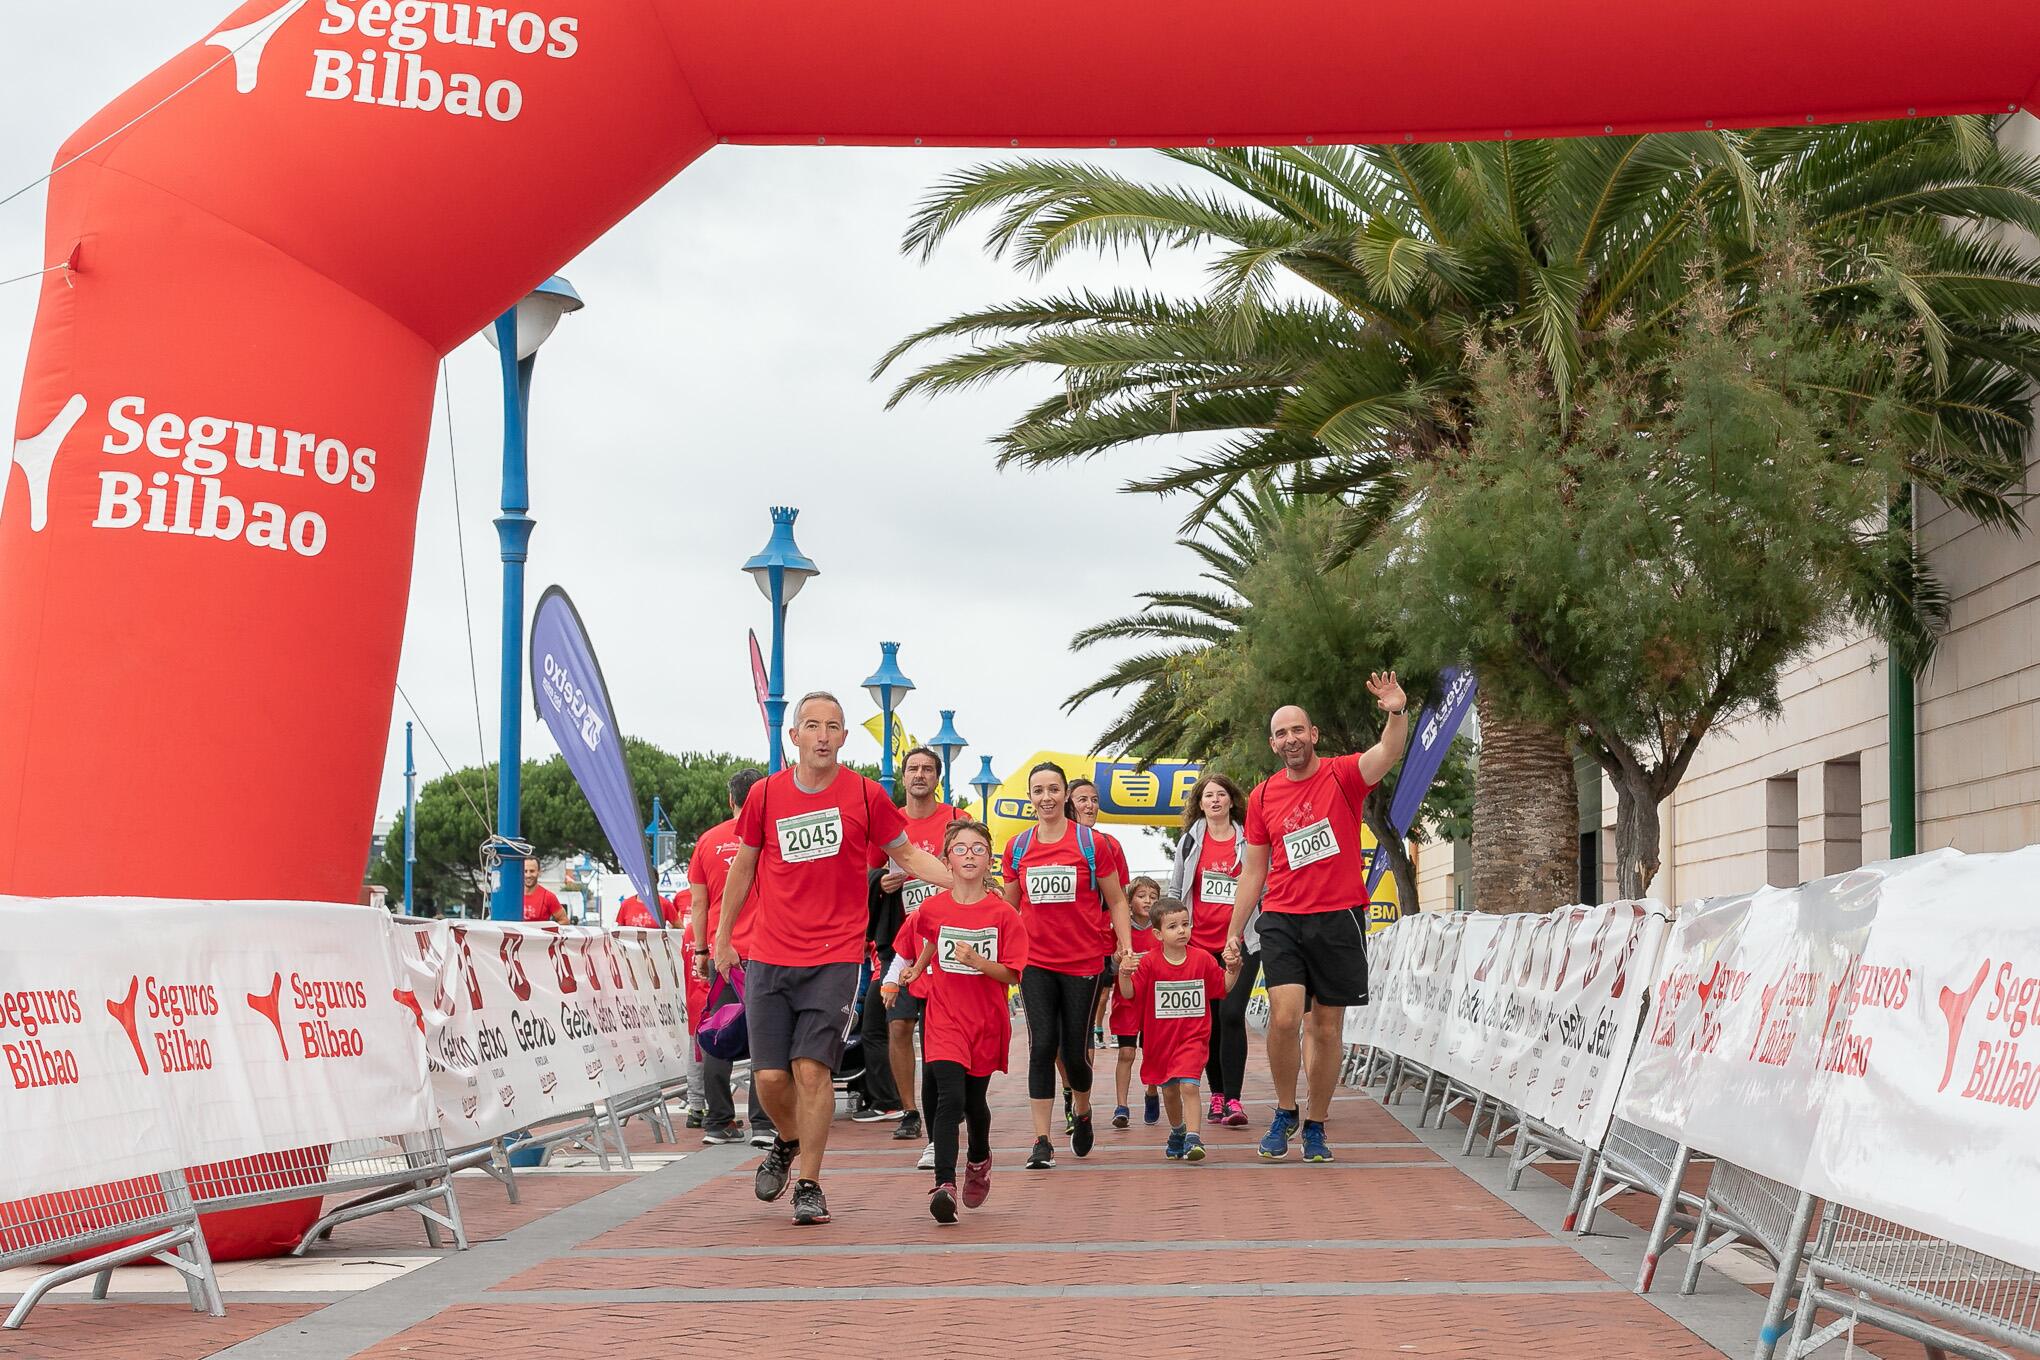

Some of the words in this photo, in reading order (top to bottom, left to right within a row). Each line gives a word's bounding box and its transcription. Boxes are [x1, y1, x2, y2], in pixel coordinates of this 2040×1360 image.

[319, 0, 579, 58] Seguros
[306, 49, 523, 122] Bilbao
[102, 395, 377, 493] Seguros
[92, 471, 327, 557] Bilbao
[786, 822, 838, 852] 2045
[1290, 830, 1331, 860] 2060
[1031, 875, 1071, 895] 2060
[1369, 904, 1397, 921] BM
[146, 975, 219, 1027] Seguros
[291, 972, 367, 1018] Seguros
[1161, 990, 1201, 1009] 2060
[154, 1029, 213, 1073] Bilbao
[299, 1020, 364, 1060] Bilbao
[438, 1025, 479, 1069] Getxo
[478, 1018, 509, 1062] etxo
[511, 1009, 556, 1052] Getxo
[2, 1039, 80, 1090] Bilbao
